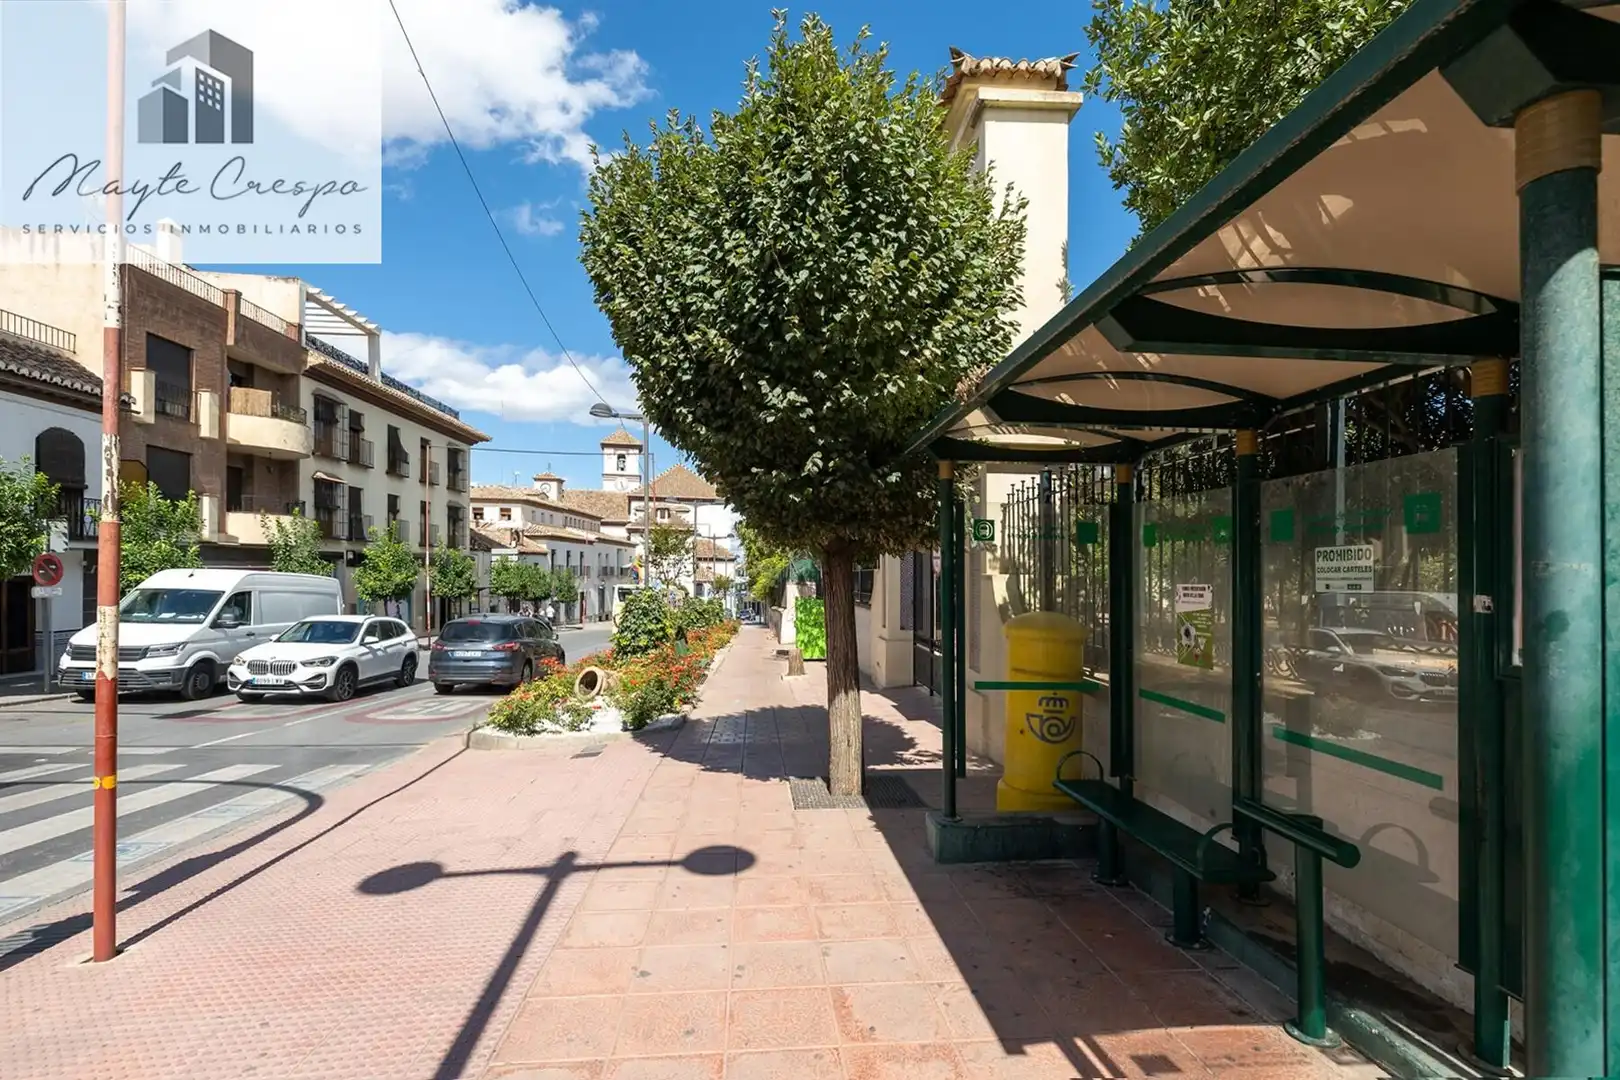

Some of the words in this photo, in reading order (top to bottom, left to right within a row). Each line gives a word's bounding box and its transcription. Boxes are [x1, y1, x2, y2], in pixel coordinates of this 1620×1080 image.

[1316, 548, 1372, 562] PROHIBIDO
[1317, 566, 1341, 574] COLOCAR
[1342, 565, 1372, 573] CARTELES
